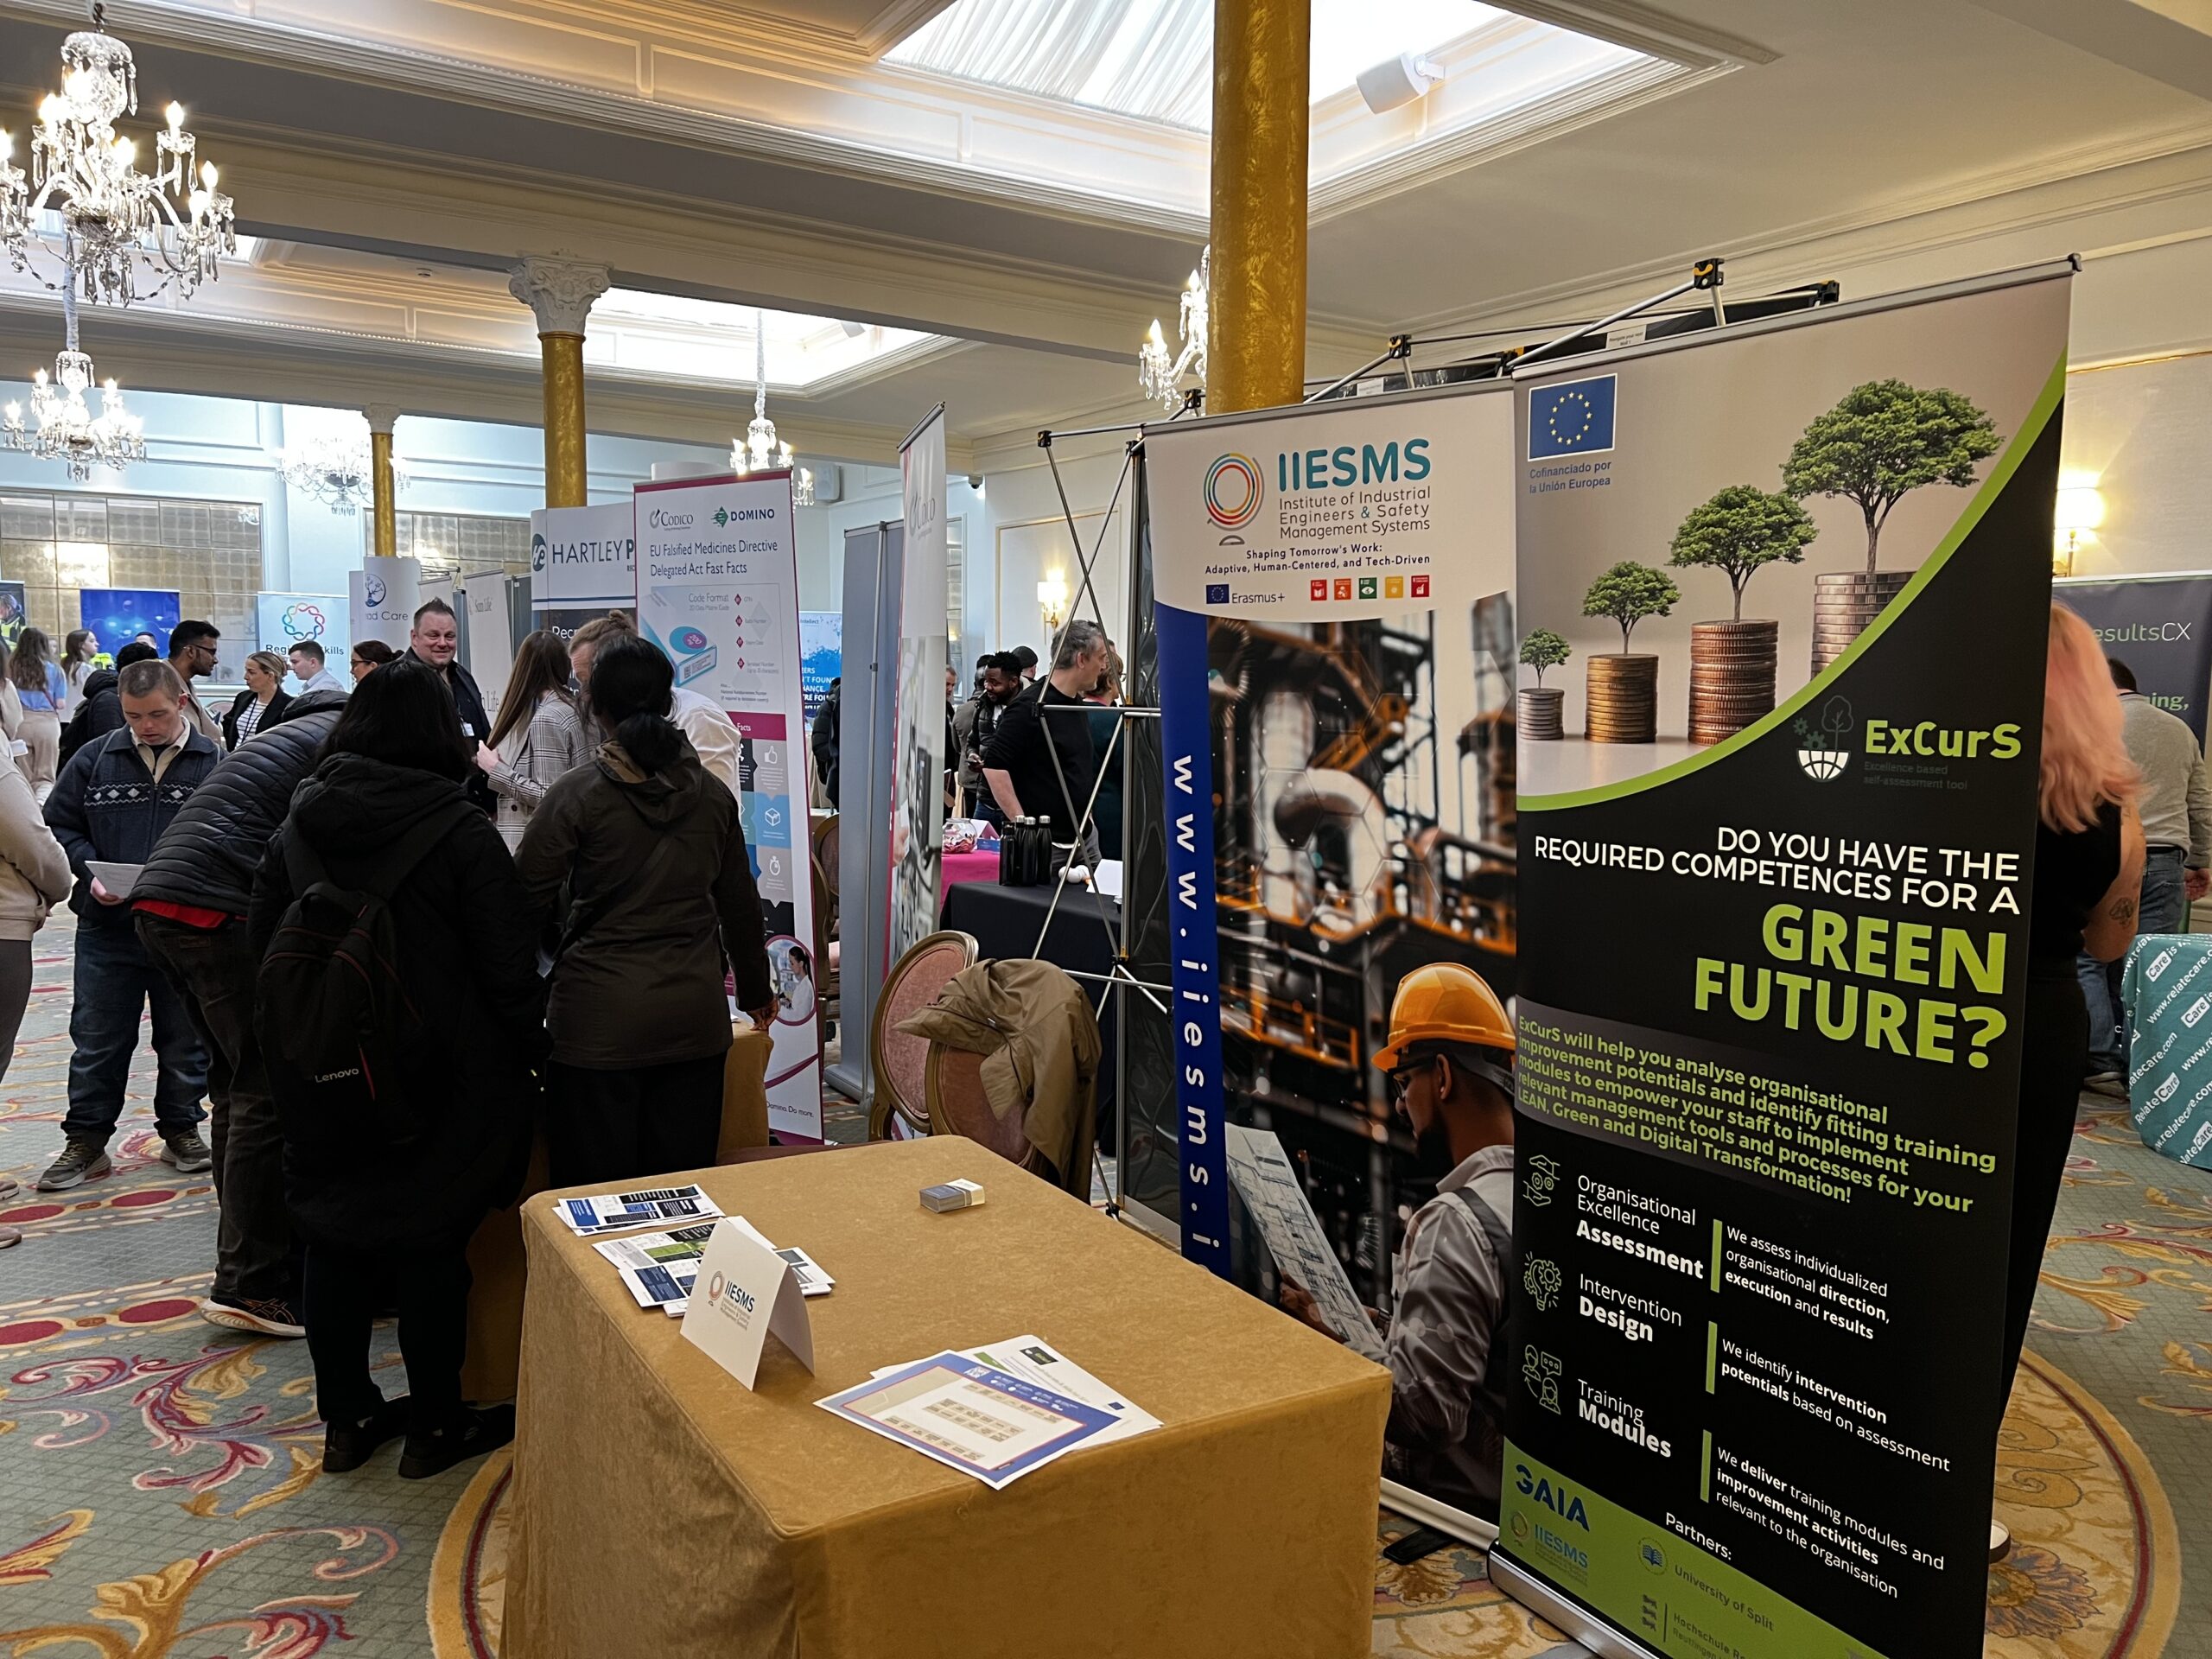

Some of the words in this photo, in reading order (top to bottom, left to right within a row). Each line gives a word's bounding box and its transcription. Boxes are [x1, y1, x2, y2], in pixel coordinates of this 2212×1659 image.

[1279, 438, 1431, 492] IIESMS
[1529, 463, 1591, 479] Cofinanciado
[1594, 461, 1611, 474] por
[1529, 484, 1536, 494] la
[1539, 480, 1566, 493] Unión
[1568, 477, 1611, 490] Europea
[730, 508, 775, 522] DOMINO
[1280, 495, 1336, 510] Institute
[1341, 492, 1354, 505] of
[1359, 486, 1431, 504] Industrial
[1280, 509, 1354, 526] Engineers
[1361, 505, 1370, 518] &
[1377, 503, 1430, 518] Safety
[650, 544, 661, 557] EU
[663, 542, 692, 556] Falsified
[695, 540, 736, 554] Medicines
[739, 539, 778, 552] Directive
[1246, 548, 1286, 561] Shaping
[1290, 545, 1347, 557] Tomorrow's
[1351, 543, 1382, 553] Work:
[1280, 523, 1367, 539] Management
[1372, 518, 1430, 536] Systems
[651, 563, 687, 579] Delegated
[689, 562, 703, 575] Act
[705, 561, 724, 574] Fast
[726, 562, 747, 574] Facts
[1205, 563, 1250, 575] Adaptive,
[1253, 560, 1339, 572] Human-Centered,
[1343, 557, 1362, 568] and
[1366, 555, 1431, 567] Tech-Driven
[381, 611, 408, 620] Care
[689, 593, 705, 602] Code
[707, 592, 729, 602] Format
[1231, 593, 1285, 604] Erasmus+
[324, 646, 344, 656] kills
[2093, 622, 2192, 642] esultsCX
[1866, 720, 2022, 759] ExCurS
[1864, 761, 1914, 772] Excellence
[1916, 766, 1948, 774] based
[1947, 780, 1968, 790] tool
[1535, 836, 1665, 872] REQUIRED
[1671, 850, 1891, 900] COMPETENCES
[1902, 878, 1978, 912] FOR
[1988, 886, 2021, 915] A
[1718, 827, 1760, 854] DO
[1768, 830, 1830, 863] YOU
[1839, 840, 1928, 874] HAVE
[1939, 848, 2020, 882] THE
[1763, 904, 2007, 995] GREEN
[2166, 946, 2177, 957] is
[1694, 957, 2008, 1070] FUTURE?
[2184, 1001, 2207, 1024] Care
[315, 1067, 359, 1084] Lenovo
[1519, 1015, 1560, 1042] ExCurS
[1564, 1031, 1593, 1050] will
[1598, 1037, 1636, 1062] help
[1638, 1049, 1671, 1067] you
[1675, 1058, 1745, 1085] analyse
[1749, 1076, 1888, 1124] organisational
[1519, 1032, 1612, 1073] improvement
[1617, 1063, 1706, 1096] potentials
[1710, 1085, 1745, 1106] and
[1750, 1091, 1822, 1130] identify
[1827, 1114, 1889, 1151] fitting
[1894, 1134, 1996, 1173] training
[1519, 1054, 1571, 1082] modules
[1574, 1071, 1592, 1087] to
[1595, 1079, 1678, 1109] empower
[1682, 1100, 1724, 1121] your
[1727, 1111, 1770, 1135] staff
[1773, 1122, 1793, 1140] to
[1797, 1127, 1909, 1175] implement
[1518, 1087, 1550, 1115] LEAN,
[1553, 1103, 1599, 1128] Green
[1603, 1117, 1636, 1137] and
[1641, 1127, 1698, 1154] Digital
[1701, 1141, 1851, 1204] Transformation!
[1519, 1071, 1567, 1100] relevant
[1571, 1090, 1685, 1131] management
[1689, 1120, 1735, 1144] tools
[1738, 1135, 1774, 1155] and
[1778, 1147, 1872, 1187] processes
[1878, 1174, 1910, 1198] for
[1913, 1187, 1974, 1212] your
[1578, 1174, 1696, 1225] Organisational
[1578, 1193, 1660, 1235] Excellence
[1576, 1219, 1704, 1280] Assessment
[1727, 1225, 1748, 1243] We
[1750, 1236, 1791, 1261] assess
[1795, 1250, 1888, 1297] individualized
[725, 1281, 755, 1313] IIESMS
[1580, 1273, 1682, 1327] Intervention
[1725, 1271, 1791, 1306] execution
[1795, 1298, 1820, 1317] and
[1823, 1309, 1873, 1339] results
[1726, 1250, 1815, 1293] organisational
[1819, 1284, 1890, 1324] direction,
[1580, 1295, 1653, 1342] Design
[1578, 1378, 1644, 1426] Training
[1722, 1338, 1743, 1358] We
[1745, 1348, 1792, 1382] identify
[1796, 1370, 1887, 1424] intervention
[1579, 1398, 1672, 1458] Modules
[1721, 1362, 1789, 1402] potentials
[1793, 1392, 1831, 1422] based
[1835, 1415, 1853, 1433] on
[1857, 1426, 1950, 1472] assessment
[1717, 1468, 1809, 1528] improvement
[1812, 1520, 1878, 1565] activities
[1718, 1446, 1738, 1467] We
[1740, 1459, 1788, 1492] deliver
[1790, 1484, 1841, 1525] training
[1845, 1515, 1908, 1555] modules
[1912, 1548, 1944, 1570] and
[1535, 1523, 1588, 1568] IIESMS
[1666, 1512, 1732, 1560] Partners:
[1716, 1491, 1767, 1527] relevant
[1770, 1518, 1783, 1535] to
[1786, 1528, 1808, 1549] the
[1811, 1542, 1898, 1599] organisation
[1675, 1565, 1730, 1606] University
[1732, 1601, 1745, 1613] of
[1747, 1607, 1774, 1632] Split
[1674, 1612, 1730, 1654] Hochschule
